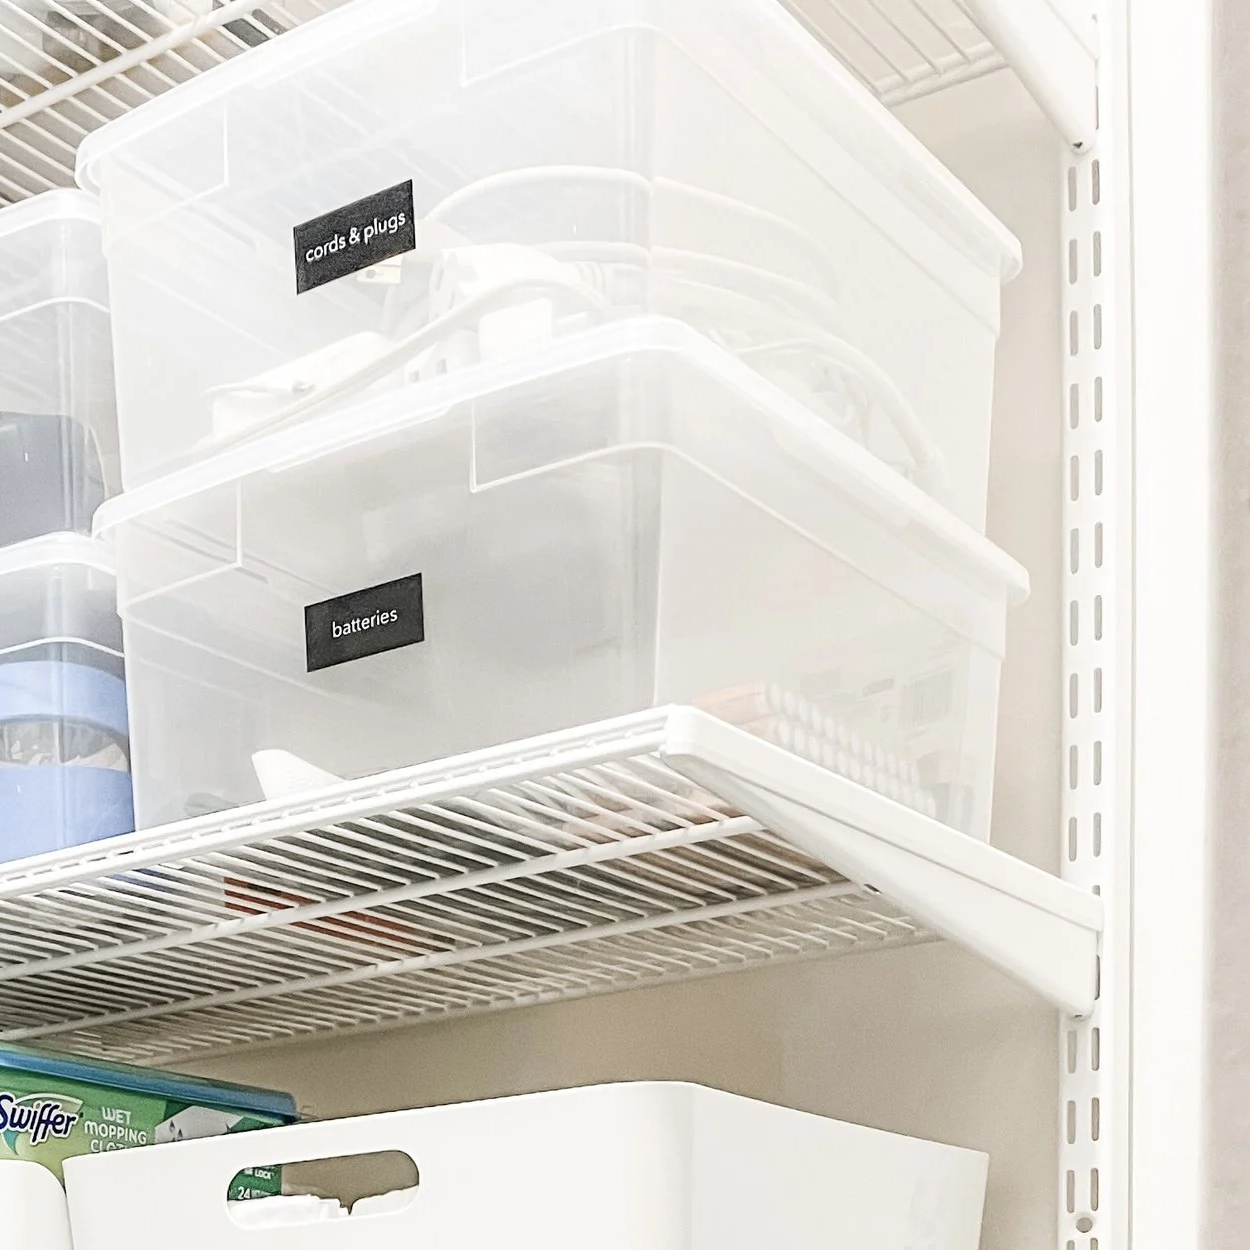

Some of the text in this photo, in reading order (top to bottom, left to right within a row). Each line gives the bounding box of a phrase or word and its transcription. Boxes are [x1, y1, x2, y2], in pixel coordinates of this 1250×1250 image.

[306, 212, 405, 262] cords & plugs
[332, 609, 398, 638] batteries
[101, 1106, 132, 1124] WET
[84, 1120, 147, 1145] MOPPING
[237, 1186, 250, 1200] 24
